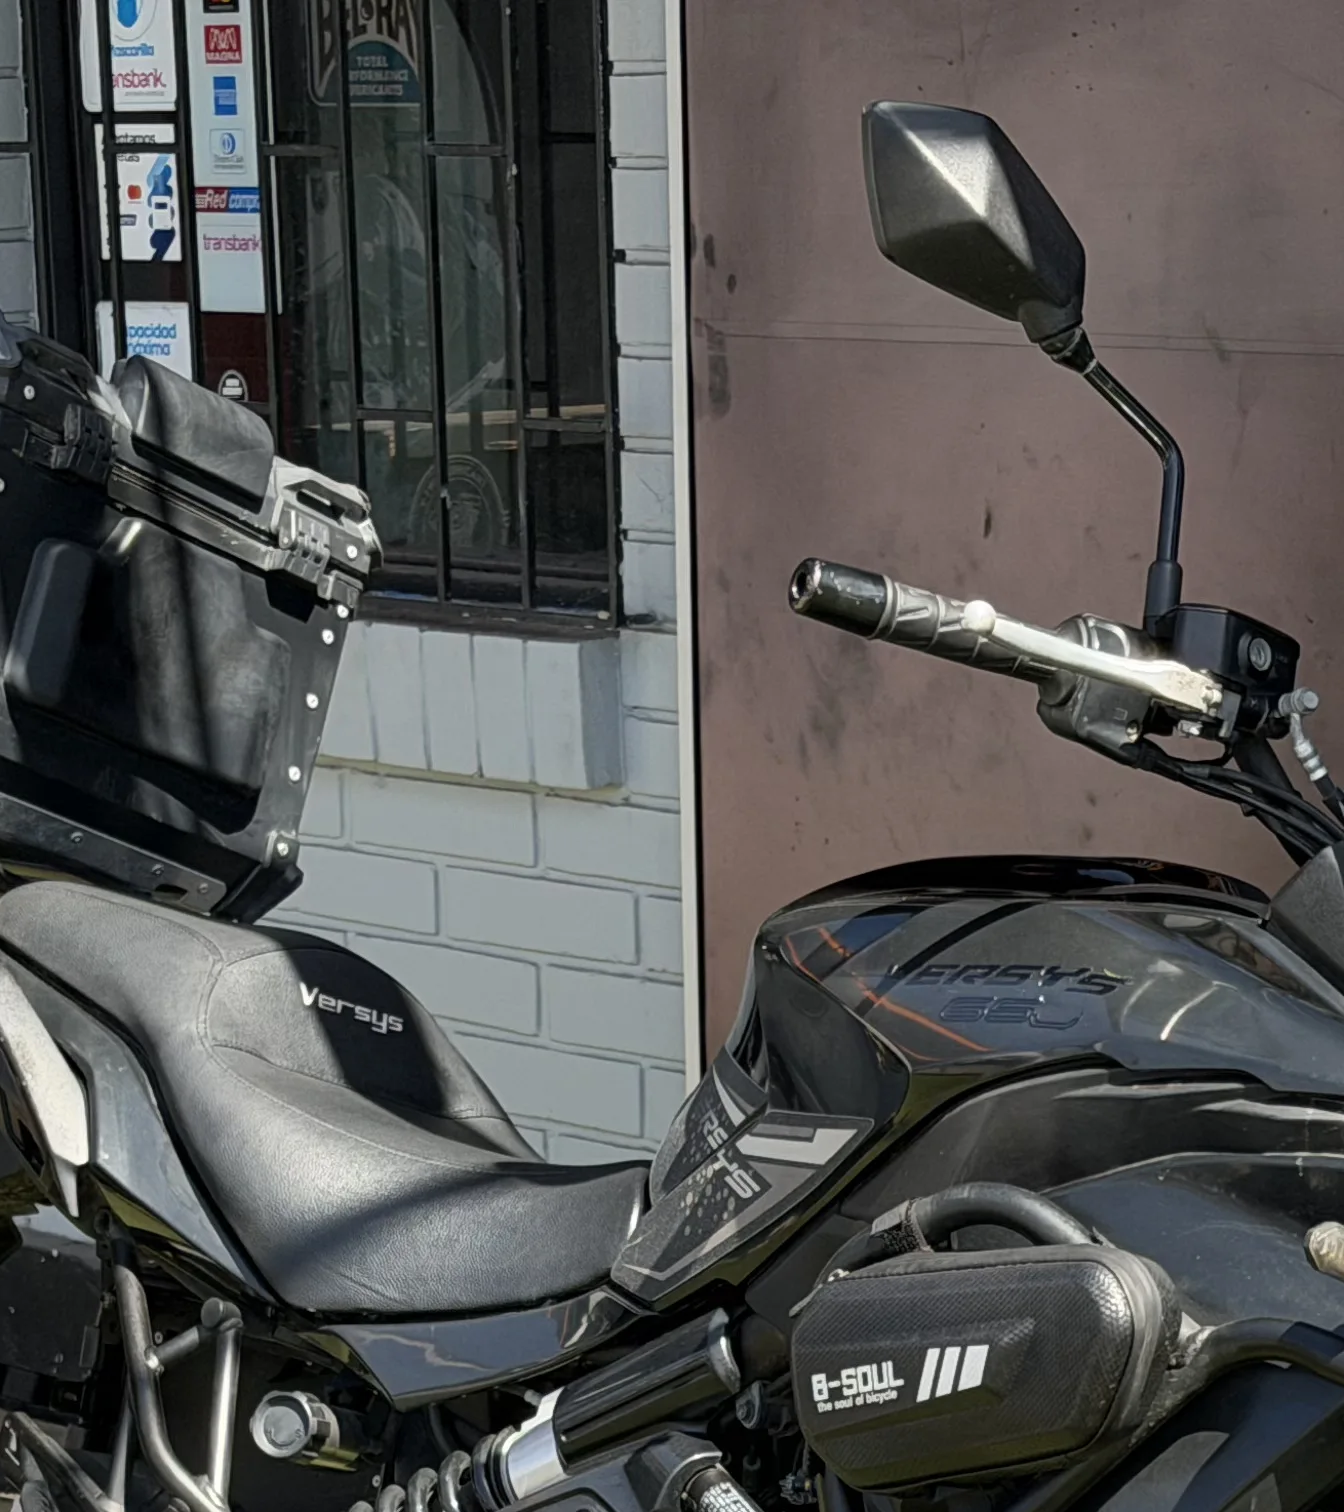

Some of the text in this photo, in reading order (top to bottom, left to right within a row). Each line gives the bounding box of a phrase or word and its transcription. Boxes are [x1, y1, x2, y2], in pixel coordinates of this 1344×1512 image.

[356, 55, 389, 68] TOTAL
[207, 188, 228, 209] Red
[128, 323, 177, 340] pacidad
[299, 981, 404, 1035] Versys
[811, 1360, 905, 1402] B-SOUL
[817, 1400, 833, 1414] the
[834, 1394, 854, 1410] soul
[865, 1389, 898, 1405] bicycle
